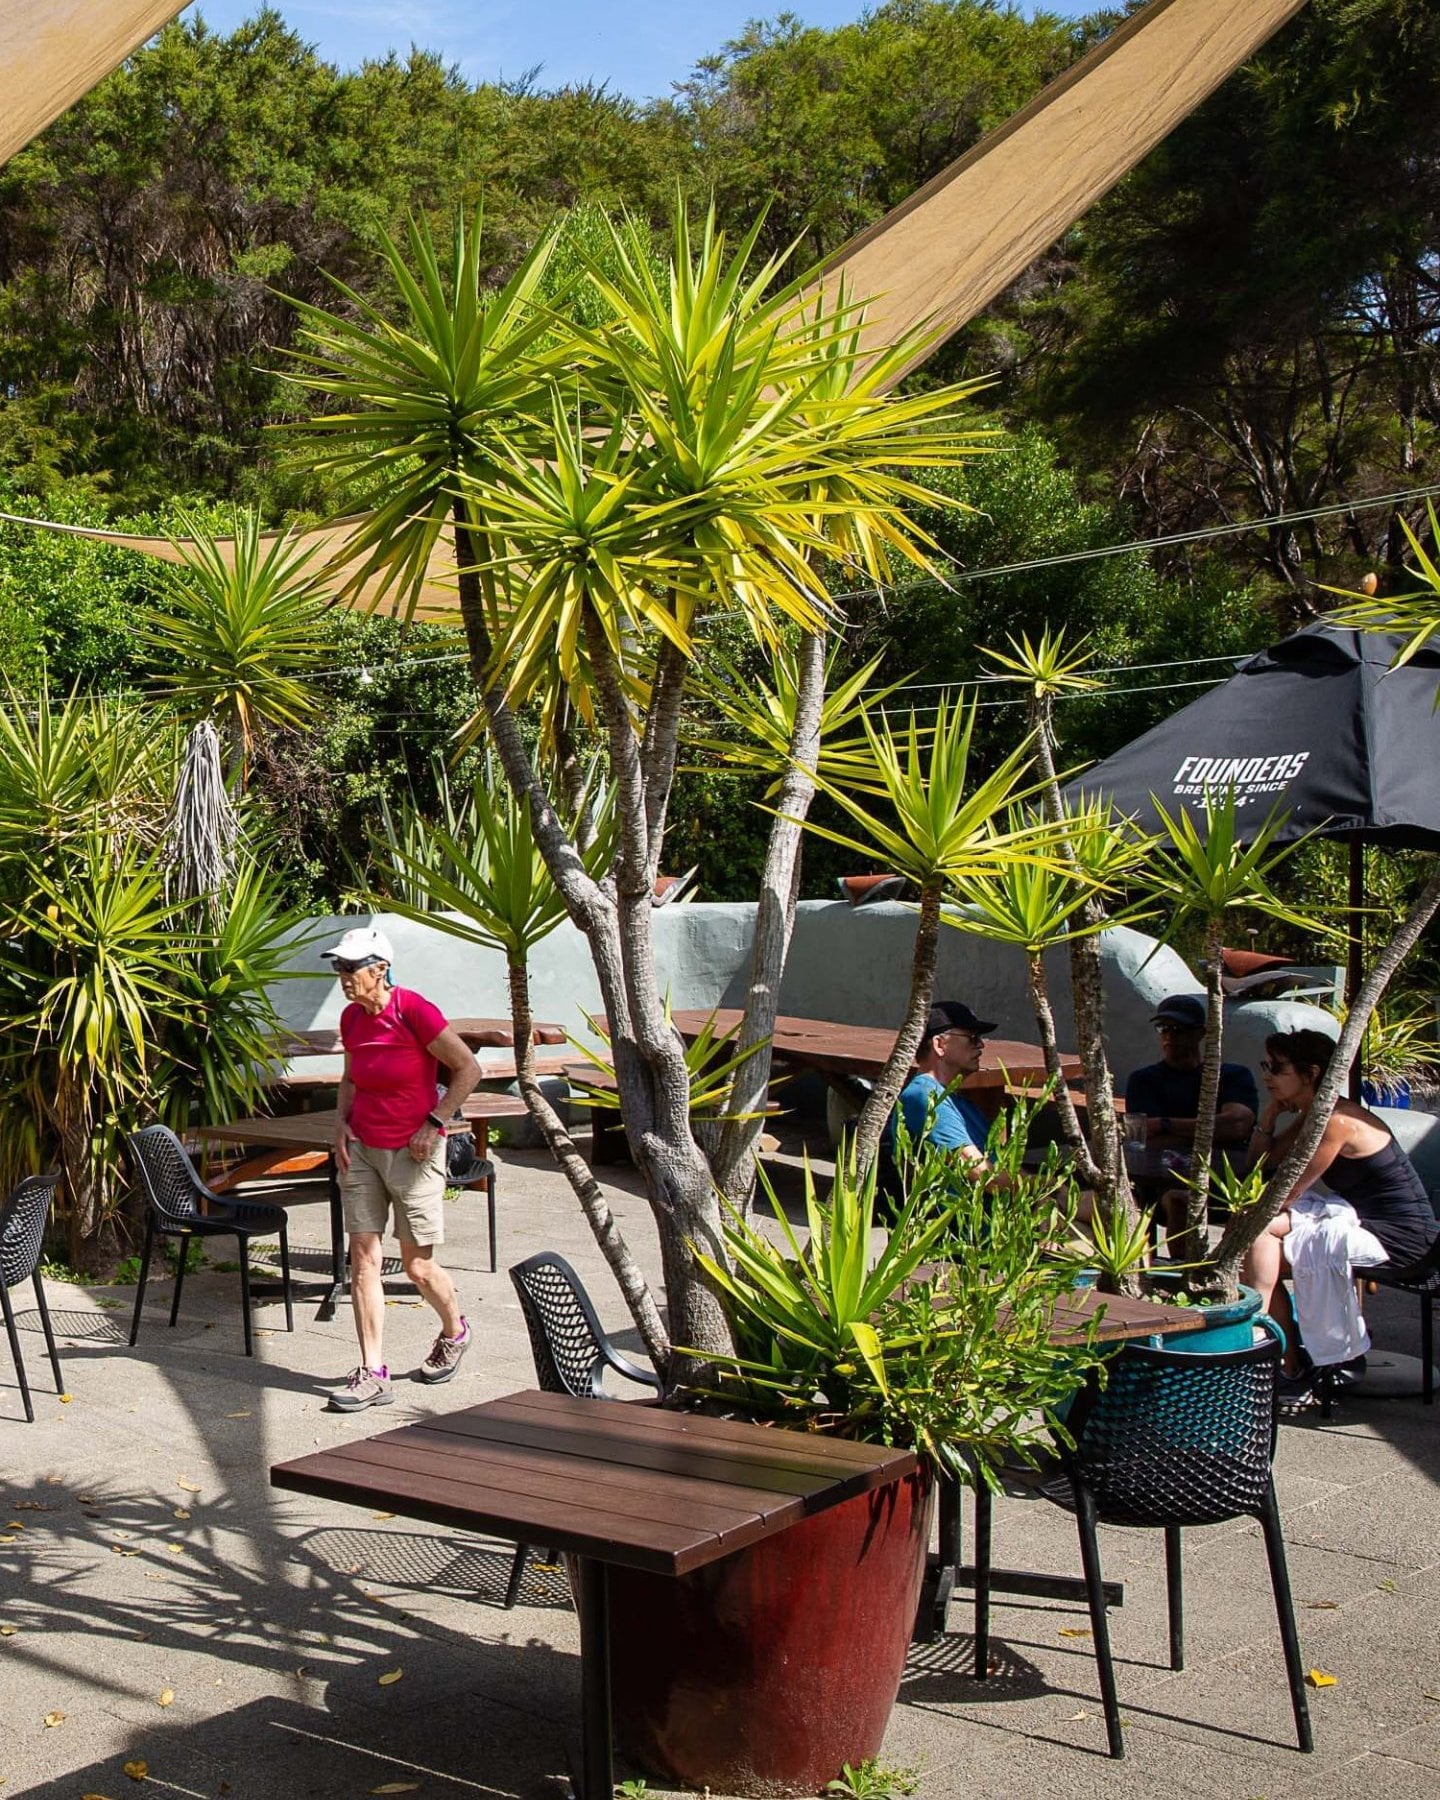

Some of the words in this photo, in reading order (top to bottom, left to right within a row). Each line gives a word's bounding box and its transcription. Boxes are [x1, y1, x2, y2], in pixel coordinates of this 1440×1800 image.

[1173, 752, 1310, 783] FOUNDERS
[1245, 780, 1288, 794] SINCE
[1197, 795, 1247, 810] 14
